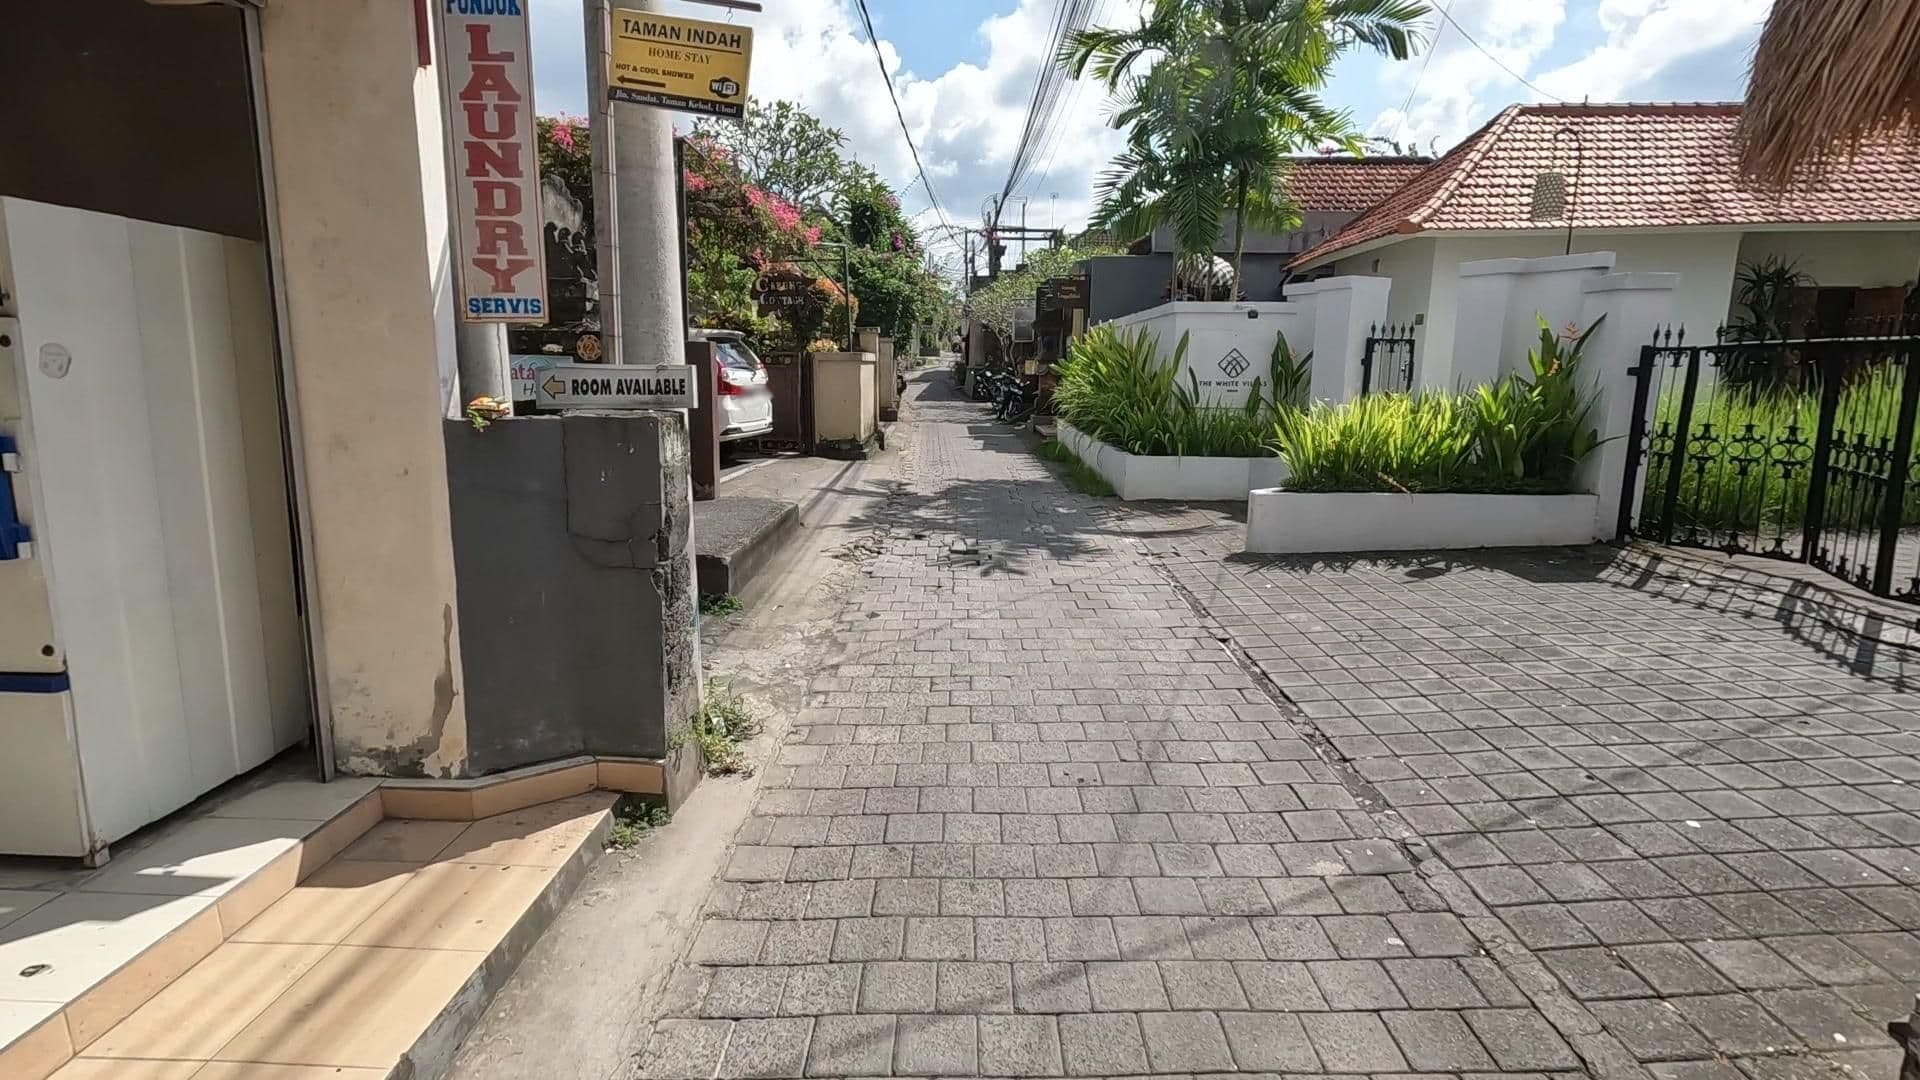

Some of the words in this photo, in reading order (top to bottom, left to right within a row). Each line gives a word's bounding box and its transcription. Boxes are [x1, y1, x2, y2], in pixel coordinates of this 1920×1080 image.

[622, 18, 681, 40] TAMAN
[687, 28, 742, 49] INDAH
[648, 47, 682, 60] HOME
[684, 52, 712, 65] STAY
[615, 62, 630, 71] HOT
[632, 65, 638, 73] &
[640, 66, 660, 76] COOL
[661, 70, 695, 80] SHOWER
[662, 95, 687, 107] Taman
[459, 24, 534, 294] LAUNDRY
[468, 297, 542, 315] SERVIS
[571, 379, 612, 396] ROOM
[616, 378, 686, 396] AVAILABLE
